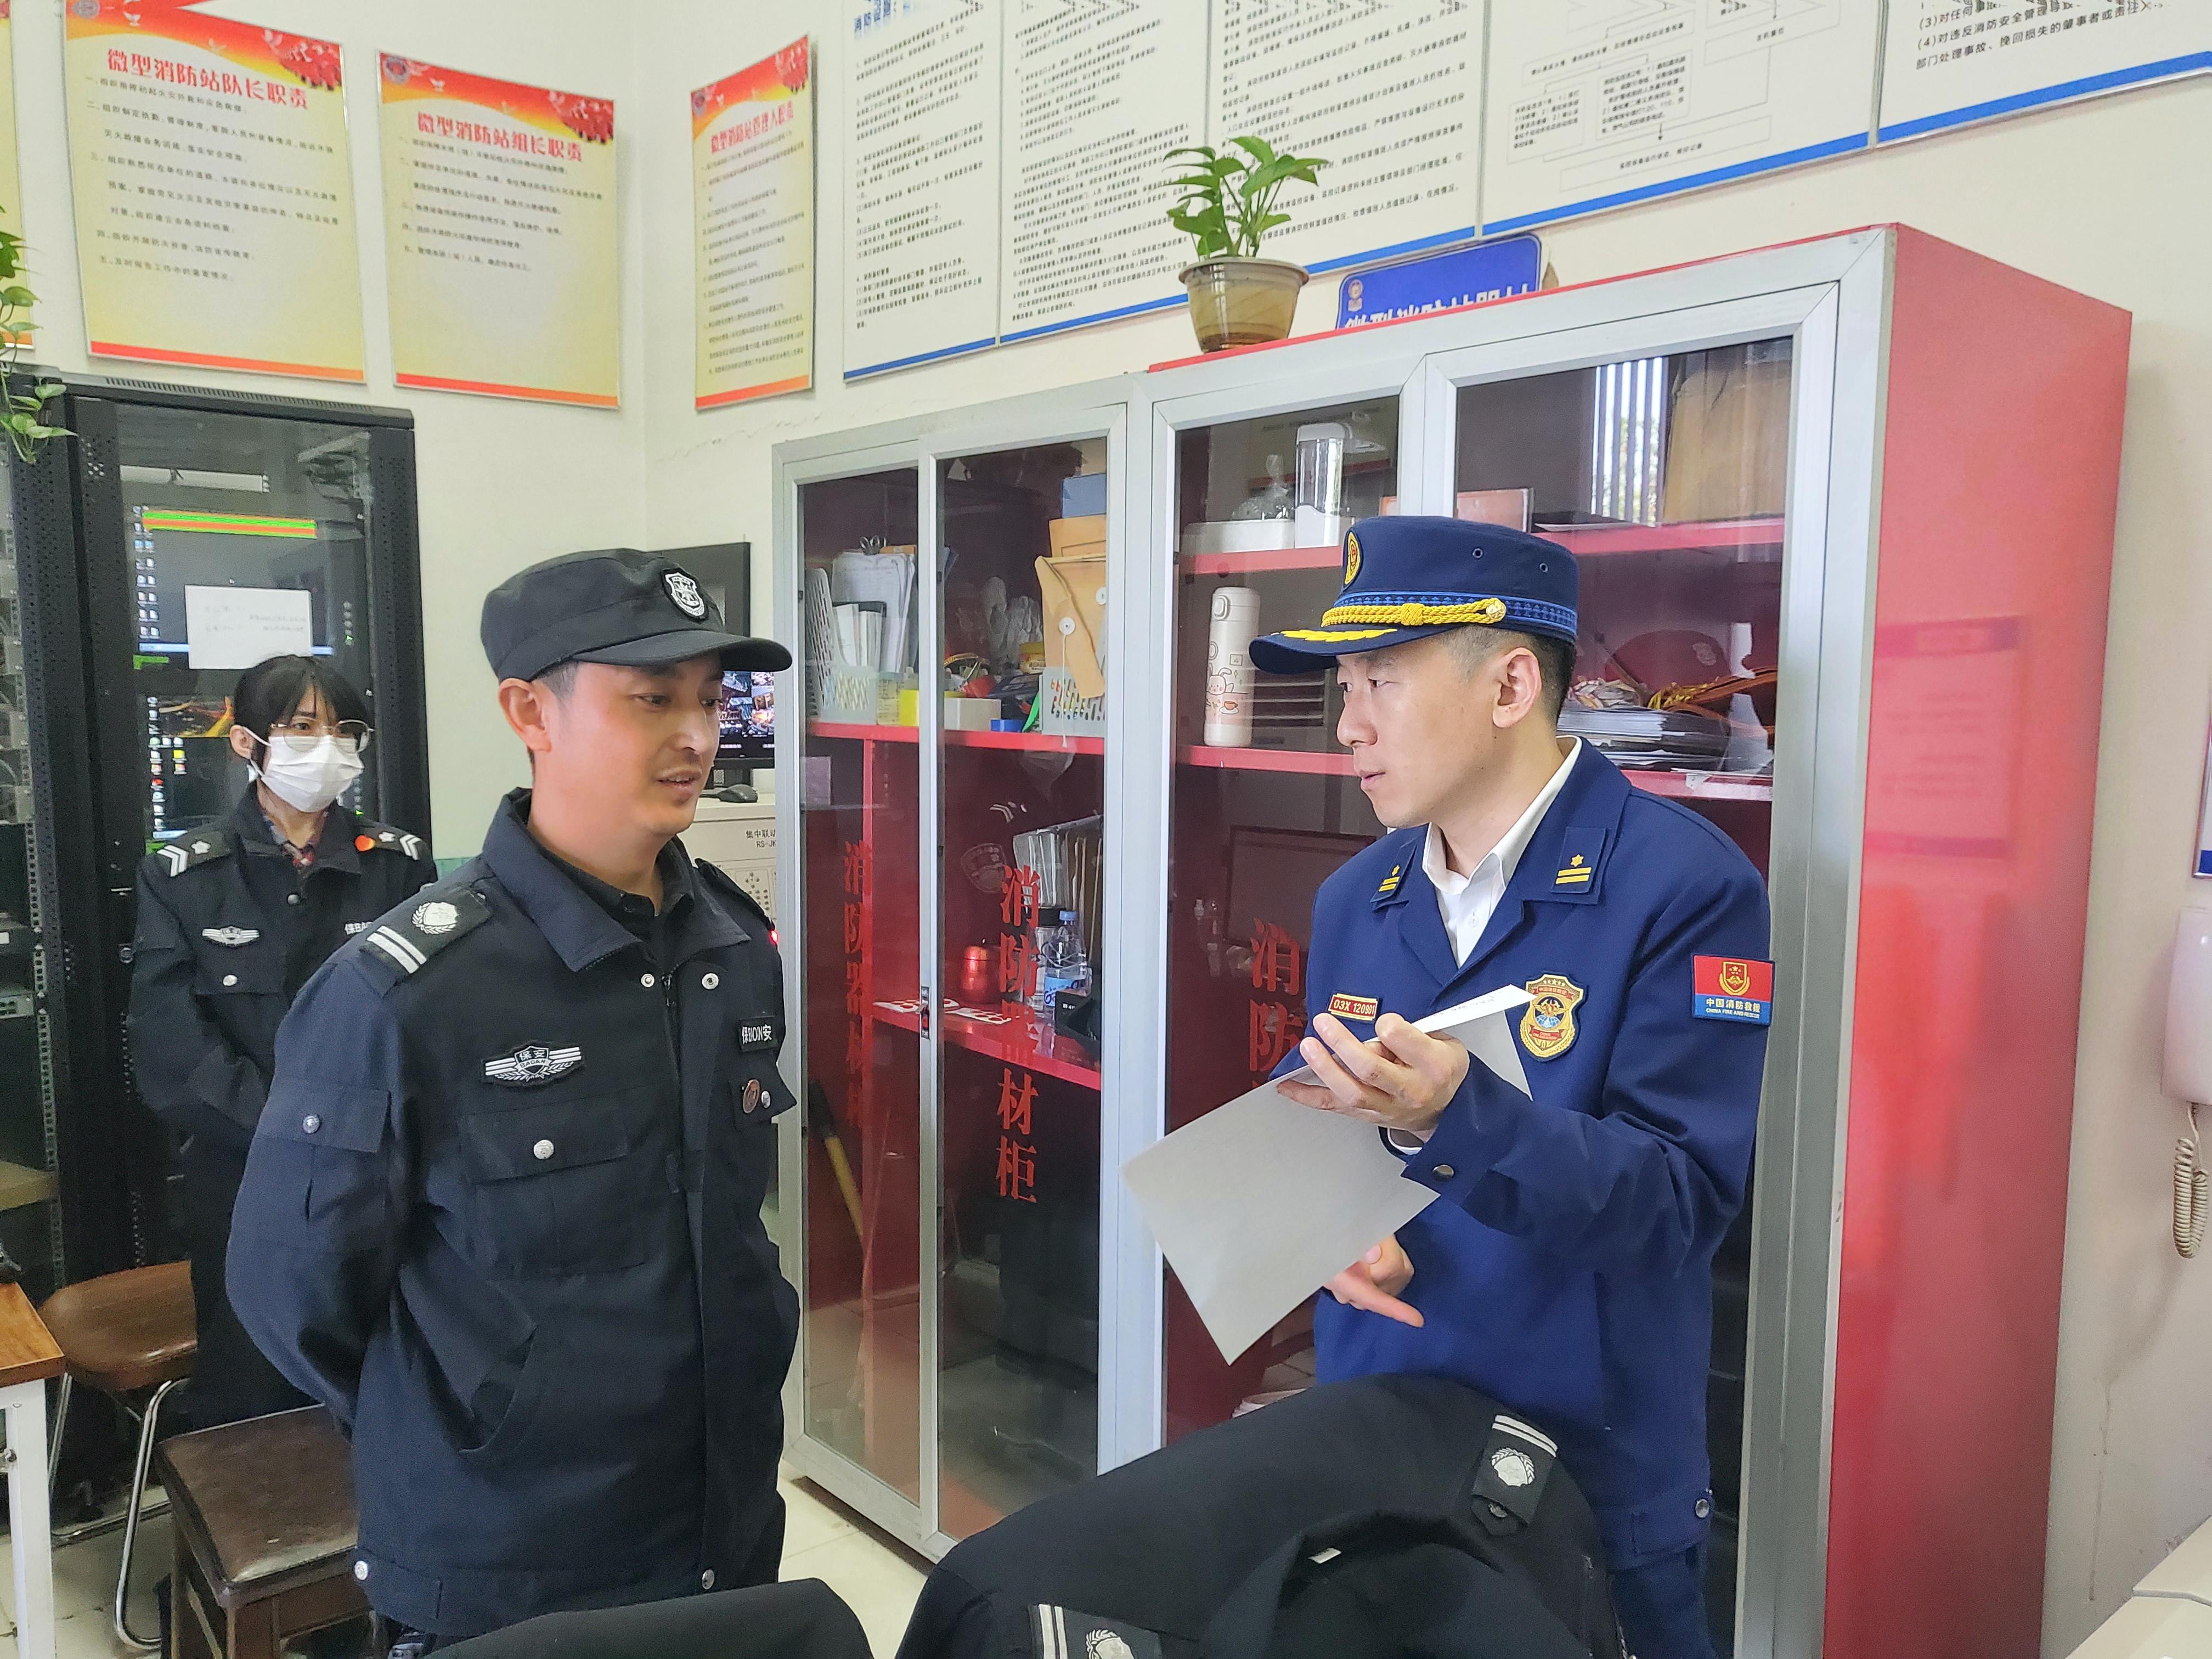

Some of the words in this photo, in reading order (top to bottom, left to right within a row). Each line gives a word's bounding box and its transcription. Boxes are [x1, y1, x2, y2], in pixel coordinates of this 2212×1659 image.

[107, 48, 308, 110] 微型消防站队长职责
[417, 111, 583, 162] 微型消防站组长职责
[1353, 1003, 1375, 1015] 120901
[1706, 997, 1760, 1013] 中国消防救援
[519, 1049, 546, 1062] 保安
